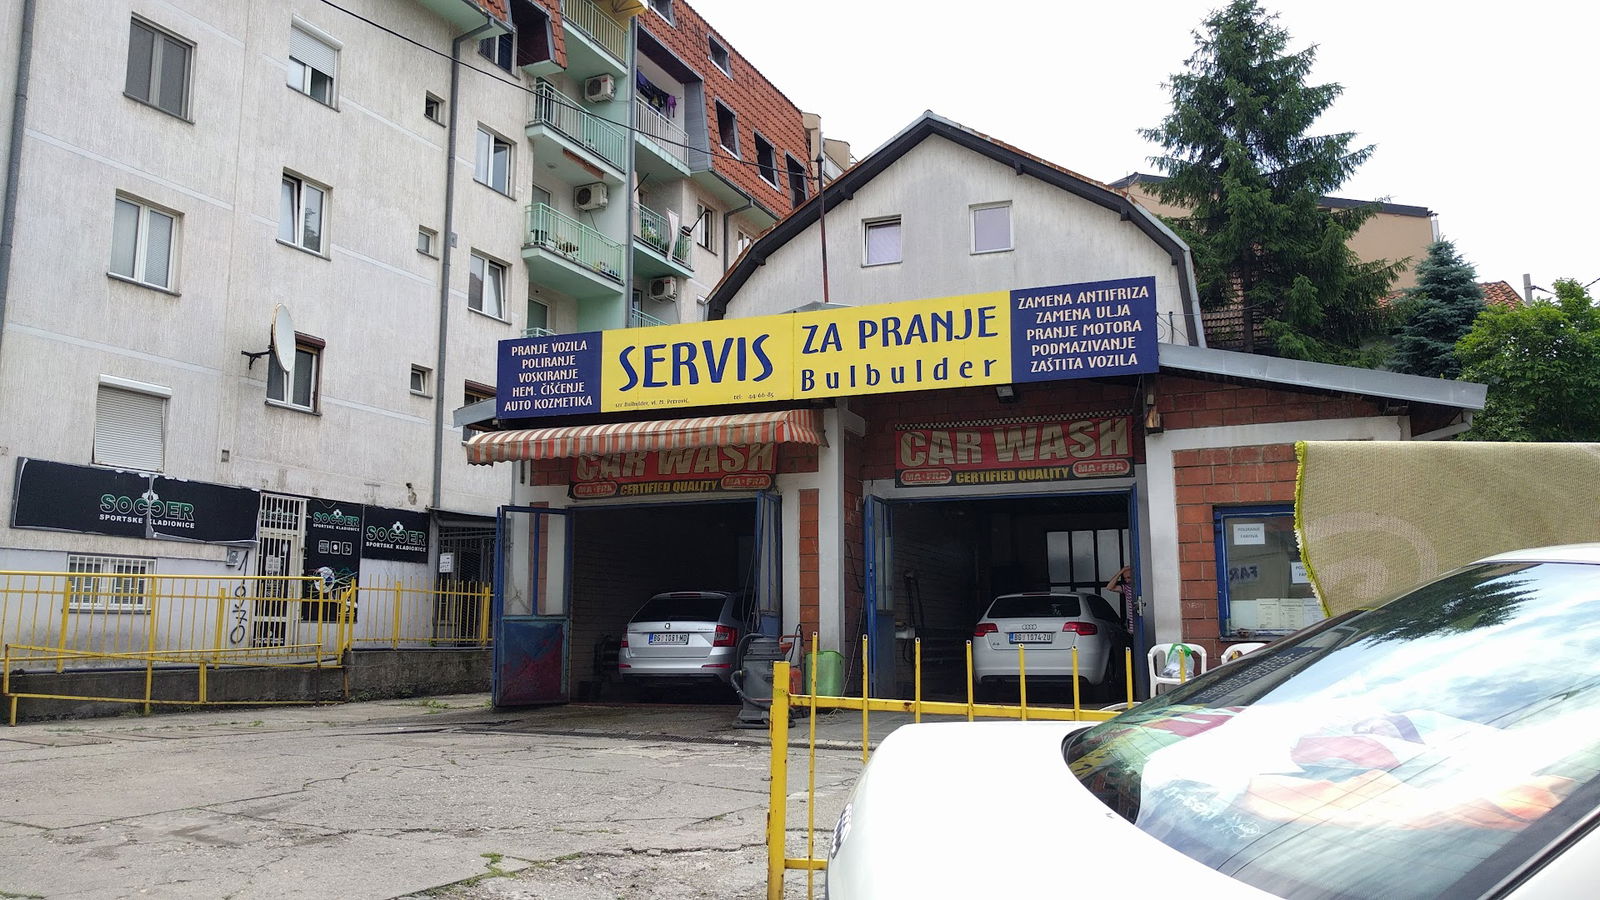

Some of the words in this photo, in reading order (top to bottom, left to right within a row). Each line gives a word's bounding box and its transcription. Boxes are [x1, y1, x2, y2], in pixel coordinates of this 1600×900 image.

[1018, 293, 1073, 310] ZAMENA
[1077, 286, 1149, 304] ANTIFRIZA
[1036, 308, 1092, 324] ZAMENA
[1096, 304, 1131, 319] ULJA
[1026, 325, 1078, 340] PRANJE
[1082, 320, 1142, 336] MOTORA
[512, 343, 549, 356] PRANJE
[552, 340, 588, 353] VOZILA
[618, 333, 774, 392] SERVIS
[801, 321, 843, 355] ZA
[858, 306, 999, 350] PRANJE
[1032, 336, 1136, 357] PODMAZIVANJE
[522, 355, 576, 369] POLIRANJE
[1030, 357, 1084, 373] ZAŠTITA
[1088, 353, 1138, 369] VOZILA
[518, 368, 579, 383] VOSKIRANJE
[801, 356, 998, 392] Bulbulder
[512, 386, 538, 398] HEM.
[540, 381, 585, 395] ČIŠĆENJE
[504, 399, 532, 412] AUTO
[534, 395, 593, 410] KOZMETIKA
[900, 429, 983, 467] CAR
[993, 417, 1129, 462] WASH
[576, 450, 650, 481] CAR
[657, 443, 775, 476] WASH
[955, 469, 1016, 484] CERTIFIED
[1018, 467, 1070, 482] QUALITY
[620, 480, 671, 495] CERTIFIED
[672, 479, 718, 494] QUALITY
[100, 493, 196, 522] SOCCER
[99, 513, 144, 524] SPORTSKE
[313, 511, 360, 528] SOCCER
[366, 525, 427, 546] SOCCER
[365, 541, 394, 550] SPORTSKE
[395, 544, 427, 553] KLADIONICE
